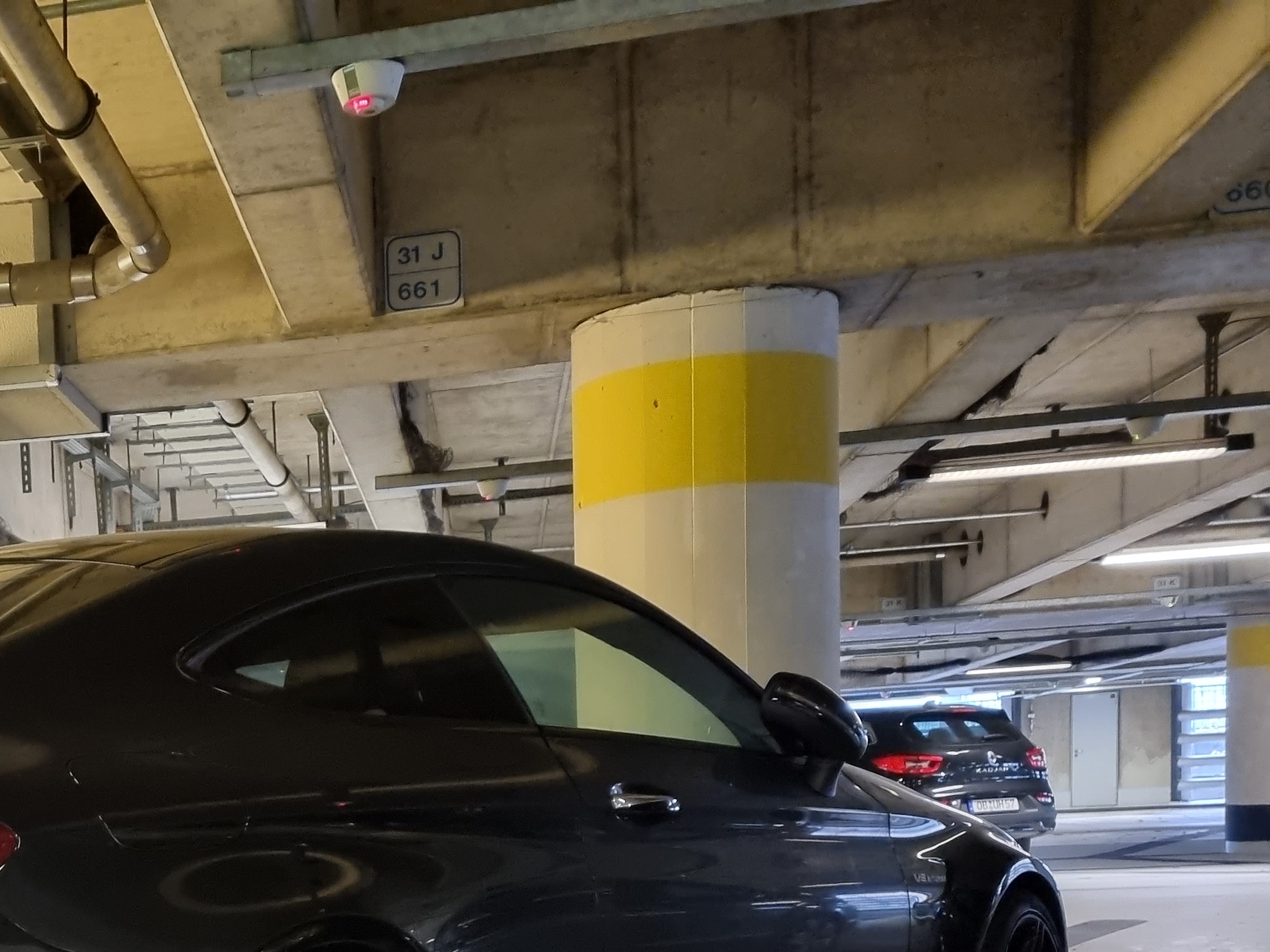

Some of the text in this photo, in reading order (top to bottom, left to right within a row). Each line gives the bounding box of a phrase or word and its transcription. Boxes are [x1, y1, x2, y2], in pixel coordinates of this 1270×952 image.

[397, 241, 444, 265] 31 J
[398, 279, 439, 301] 661
